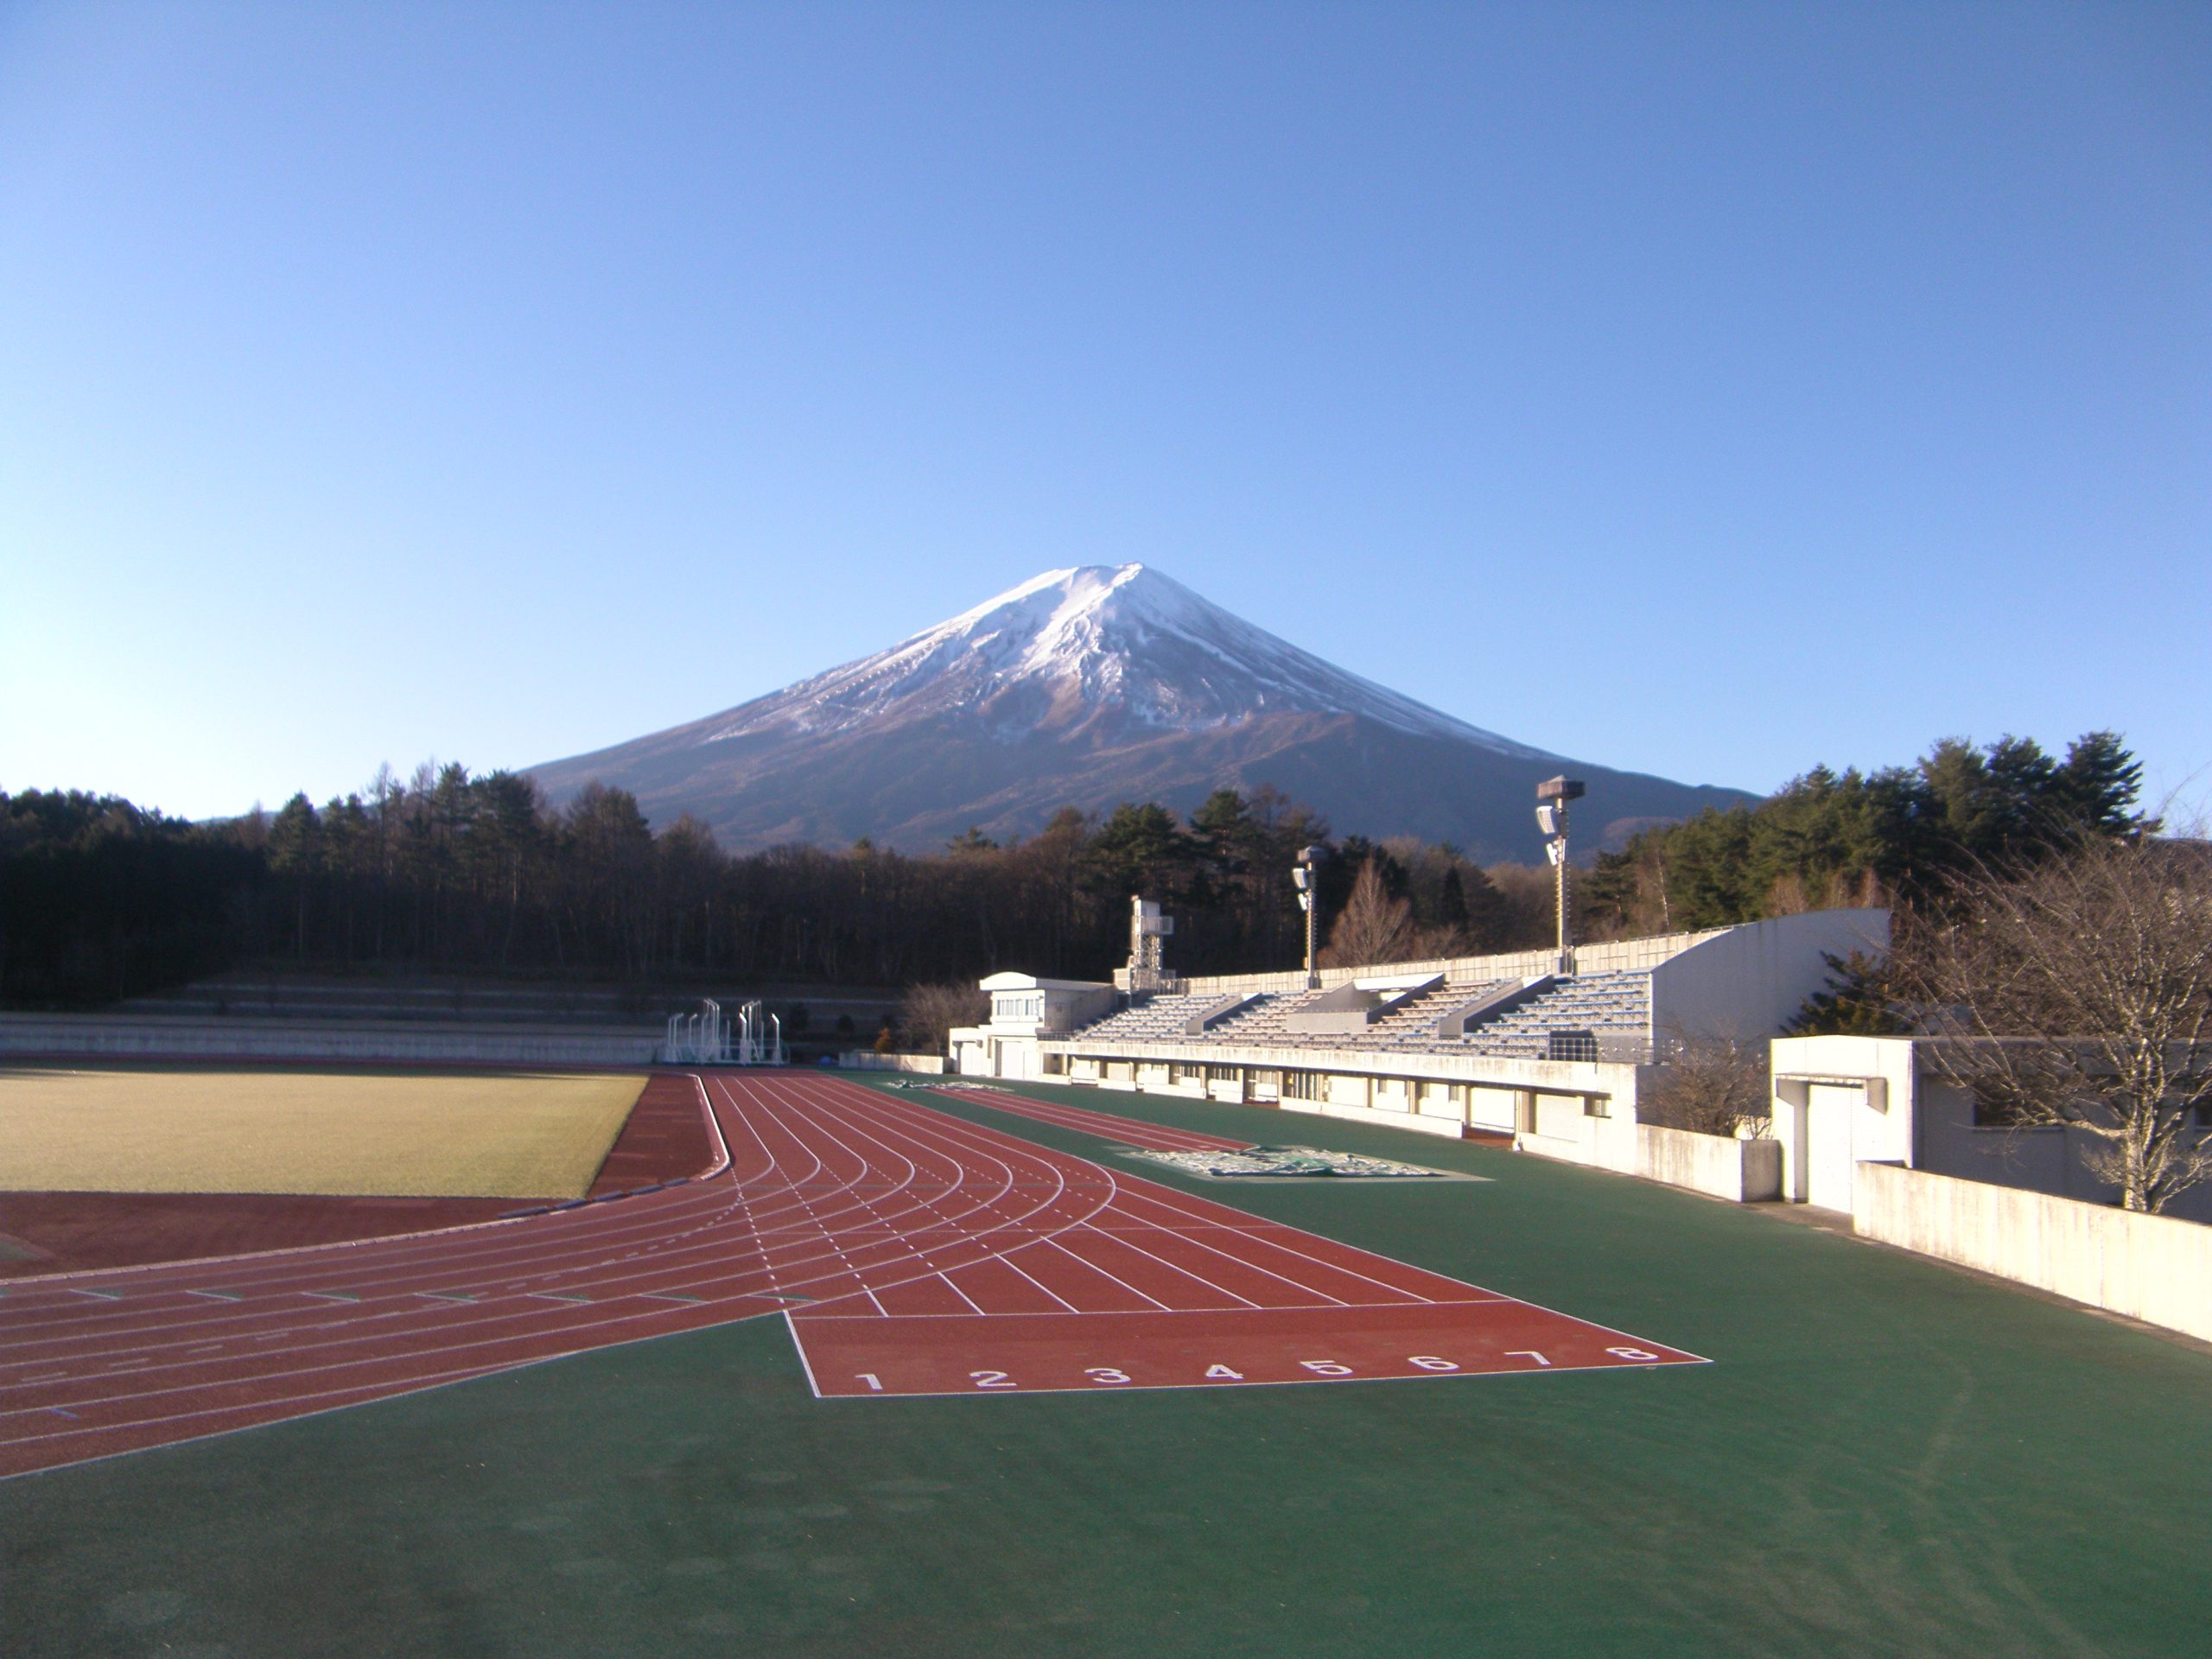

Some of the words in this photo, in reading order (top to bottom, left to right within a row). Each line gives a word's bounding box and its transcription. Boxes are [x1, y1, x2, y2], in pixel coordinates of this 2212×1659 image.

[855, 1374, 882, 1389] 1
[969, 1371, 1016, 1387] 2
[1085, 1368, 1130, 1382] 3
[1206, 1364, 1243, 1379] 4
[1300, 1360, 1352, 1375] 5
[1408, 1356, 1459, 1370] 6
[1504, 1351, 1550, 1364] 7
[1605, 1347, 1658, 1360] 8
